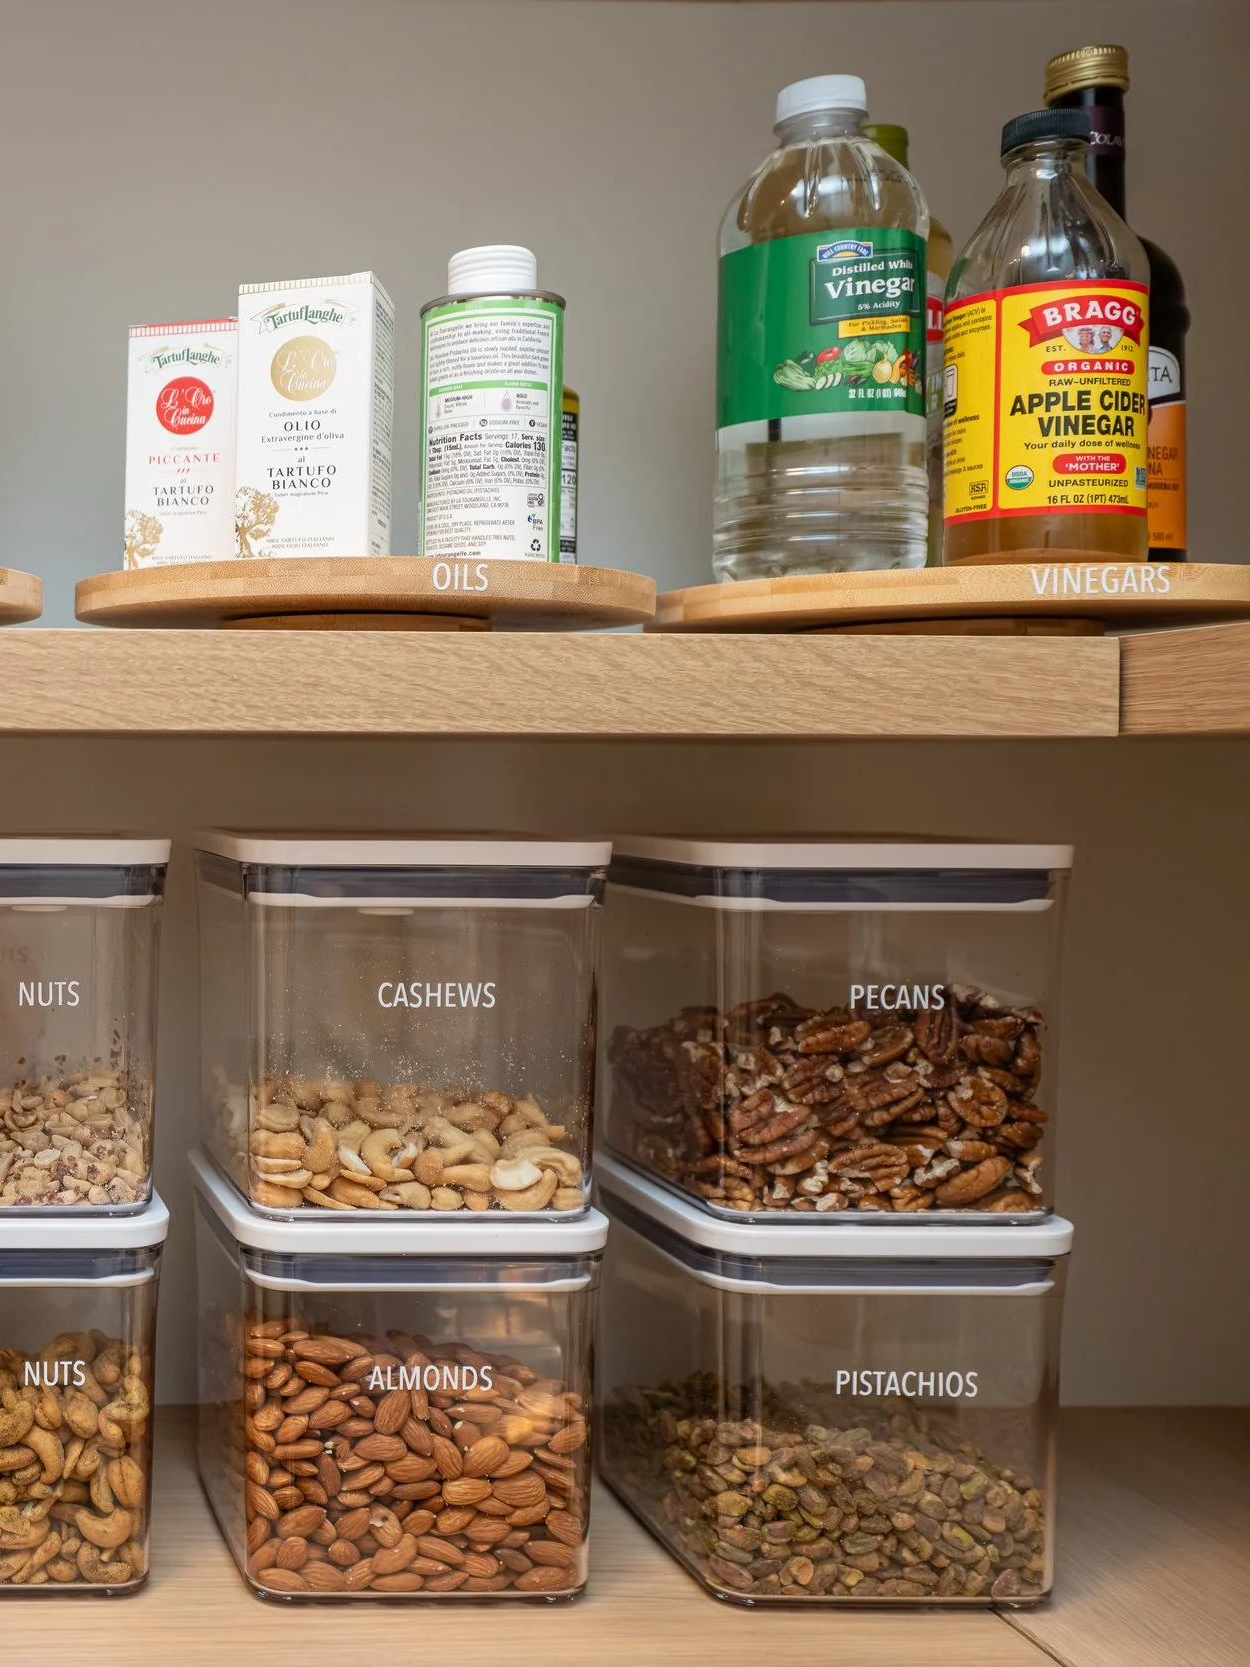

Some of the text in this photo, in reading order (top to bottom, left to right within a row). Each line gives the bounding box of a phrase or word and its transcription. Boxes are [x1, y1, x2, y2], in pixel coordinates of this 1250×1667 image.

[832, 261, 885, 277] Distilled
[824, 276, 915, 300] Vinegar
[873, 300, 901, 309] Acidity
[1043, 300, 1135, 327] BRAGG
[1046, 344, 1066, 353] EST.
[1054, 360, 1129, 372] ORGANIC
[1009, 389, 1146, 417] APPLE CIDER
[269, 409, 306, 419] Condimento
[314, 408, 329, 416] base
[284, 420, 321, 432] OLIO
[1037, 414, 1135, 438] VINEGAR
[261, 432, 344, 443] Extravergine d'oliva
[459, 433, 483, 442] Facts
[505, 441, 546, 452] Calories 130
[1024, 442, 1048, 450] Your
[1052, 440, 1076, 449] daily
[1105, 439, 1114, 447] of
[1116, 441, 1141, 450] wellness
[148, 453, 220, 465] PICCANTE
[267, 464, 336, 479] TARTUFO
[153, 484, 214, 496] TARTUFO
[272, 477, 331, 490] BIANCO
[1048, 479, 1129, 488] UNPASTEURIZED
[157, 496, 209, 507] BIANCO
[1047, 494, 1129, 504] 16 FL OZ (1PT) 473mL
[432, 562, 489, 592] OILS
[1031, 565, 1171, 595] VINEGARS
[18, 980, 81, 1007] NUTS
[377, 982, 497, 1009] CASHEWS
[849, 984, 946, 1011] PECANS
[24, 1360, 87, 1387] NUTS
[369, 1364, 494, 1392] ALMONDS
[834, 1370, 980, 1398] PISTACHIOS
